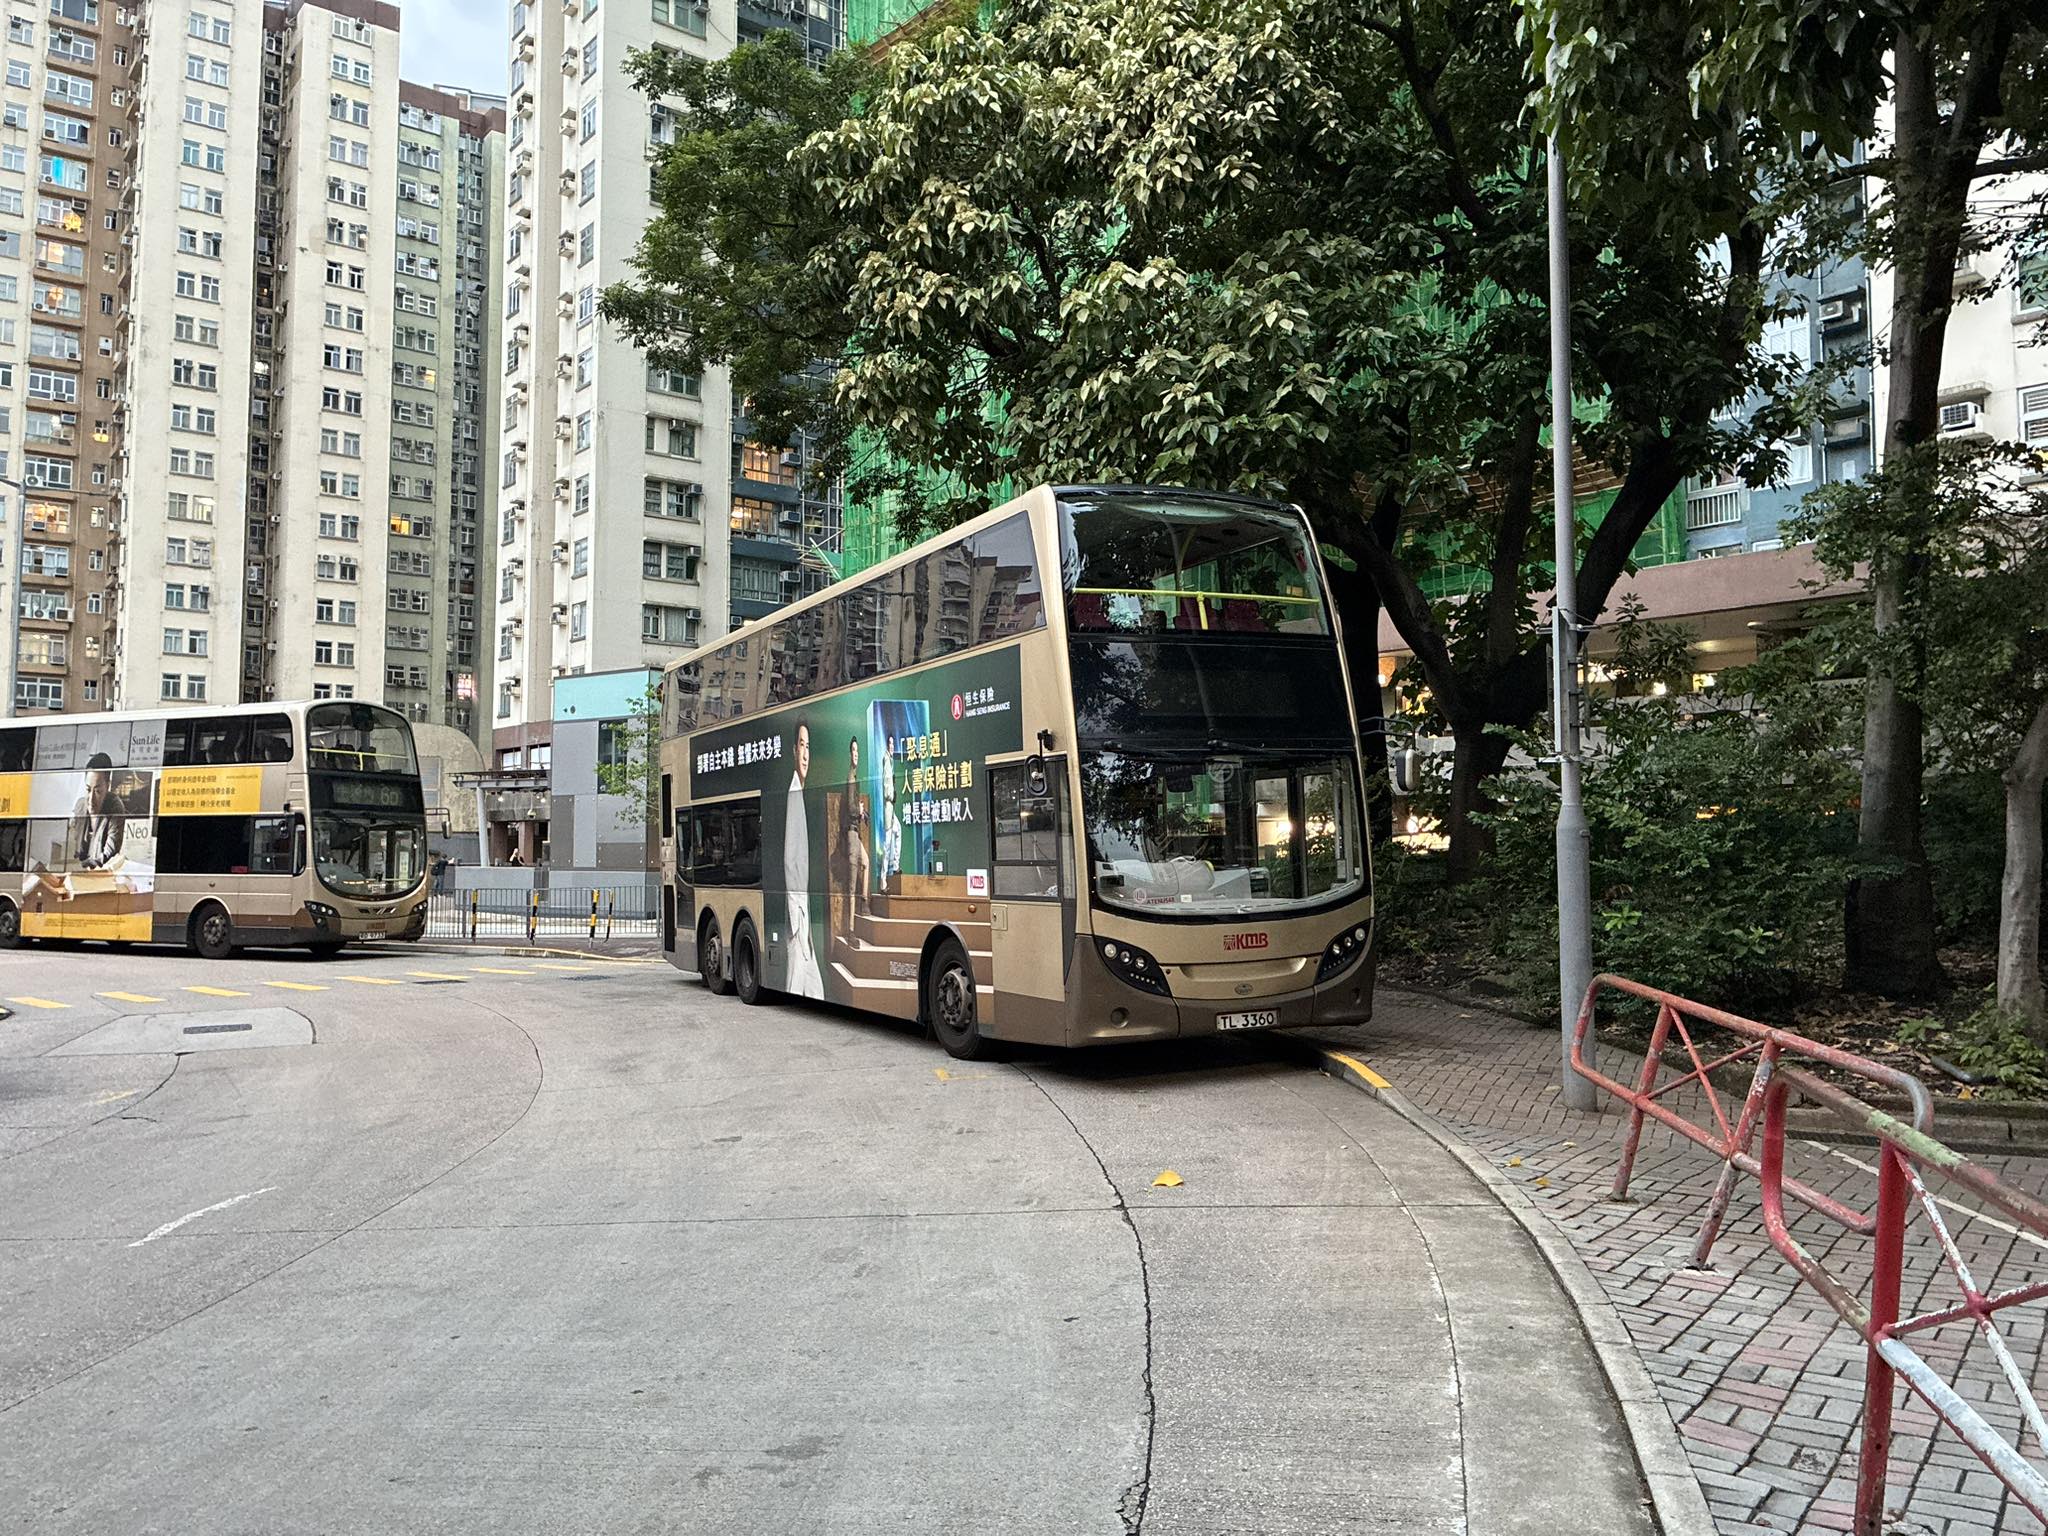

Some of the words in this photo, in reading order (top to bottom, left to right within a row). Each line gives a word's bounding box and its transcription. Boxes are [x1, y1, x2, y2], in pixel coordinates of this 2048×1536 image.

[965, 686, 994, 707] 恒生保險
[132, 736, 146, 745] Sun
[146, 734, 160, 745] Life
[697, 746, 734, 774] 部署自主本錢
[737, 735, 781, 765] 無懼未來多變
[902, 760, 972, 794] 人壽保險計劃
[902, 797, 973, 825] 增長型被動收入
[126, 822, 148, 839] Neo
[1236, 933, 1268, 950] KMB
[1220, 1015, 1237, 1029] TL
[1241, 1012, 1274, 1027] 3360
